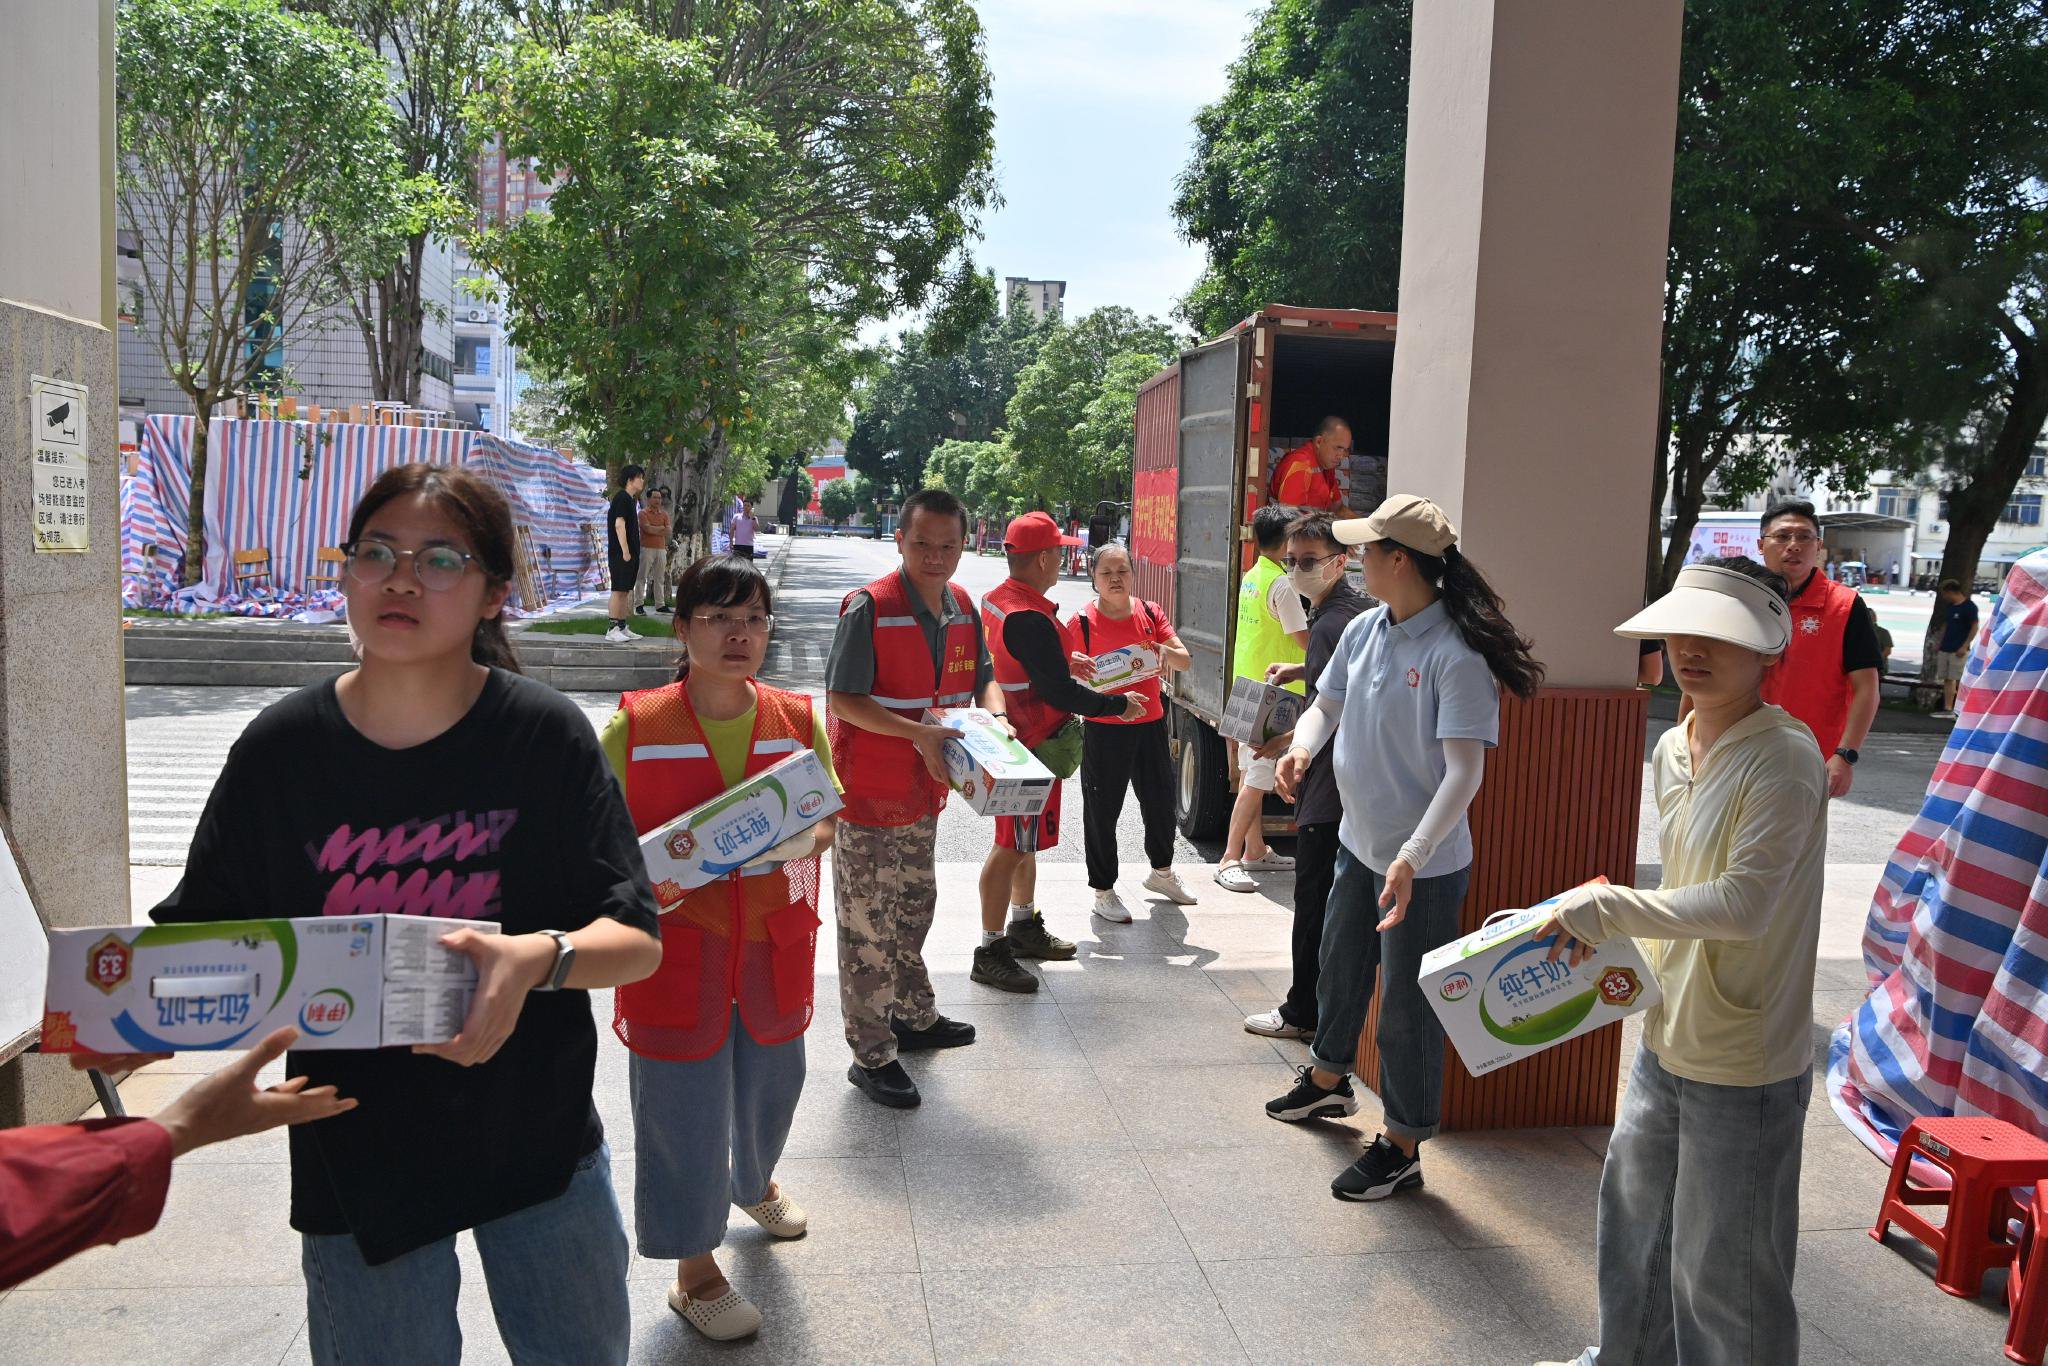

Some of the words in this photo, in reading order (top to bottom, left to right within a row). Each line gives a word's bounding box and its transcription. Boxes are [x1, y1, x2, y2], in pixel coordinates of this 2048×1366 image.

[52, 475, 86, 490] 您已进入考
[38, 492, 86, 508] 场智能巡查监控
[38, 511, 86, 526] 区域，请注意行
[38, 530, 65, 544] 为规范。
[800, 797, 822, 814] 伊利
[713, 811, 771, 857] 纯牛奶
[673, 837, 691, 852] 3.3
[98, 954, 122, 976] 3.3
[1443, 977, 1469, 996] 伊利
[1499, 959, 1572, 1002] 纯牛奶
[1604, 976, 1631, 997] 3.3
[158, 992, 250, 1027] 纯牛奶
[306, 1002, 347, 1023] 伊利
